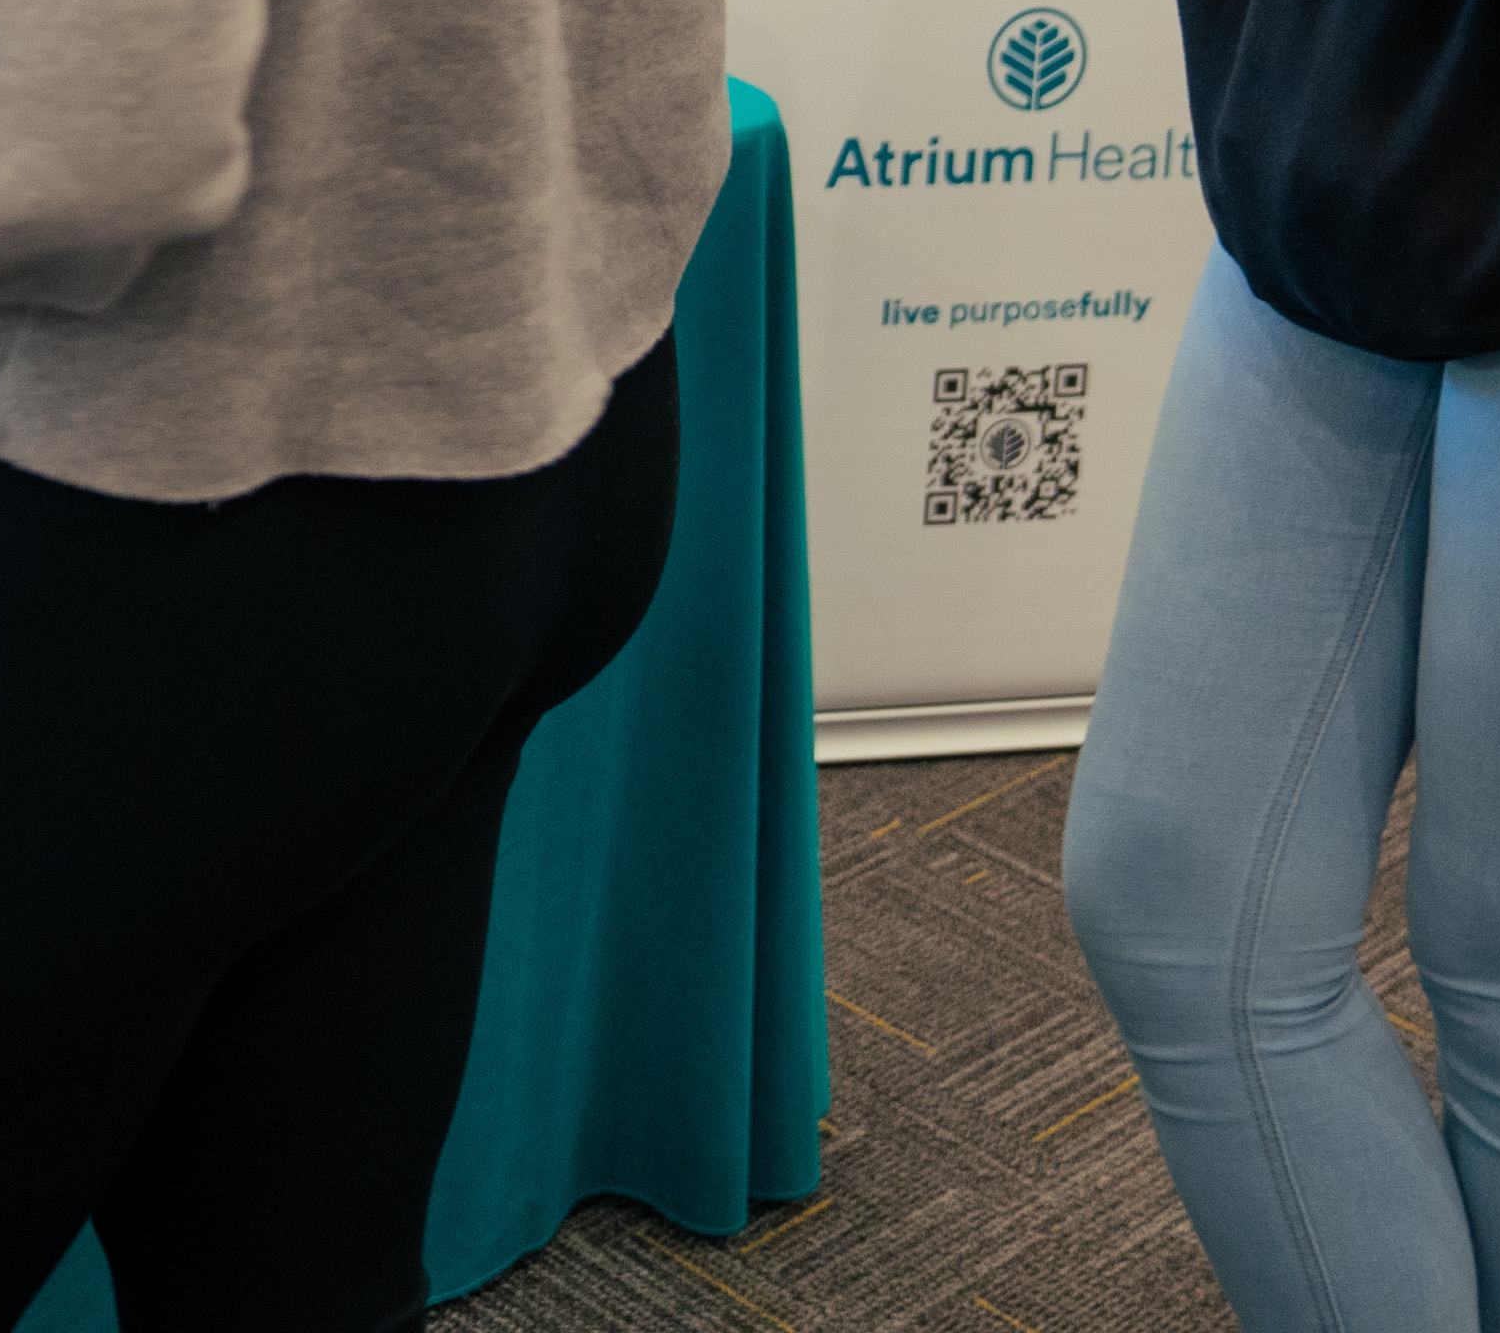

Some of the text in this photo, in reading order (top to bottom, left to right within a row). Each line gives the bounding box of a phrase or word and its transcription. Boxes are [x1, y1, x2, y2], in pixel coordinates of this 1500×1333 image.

[825, 129, 1198, 189] Atrium Healt
[881, 291, 1152, 331] live purposefully
